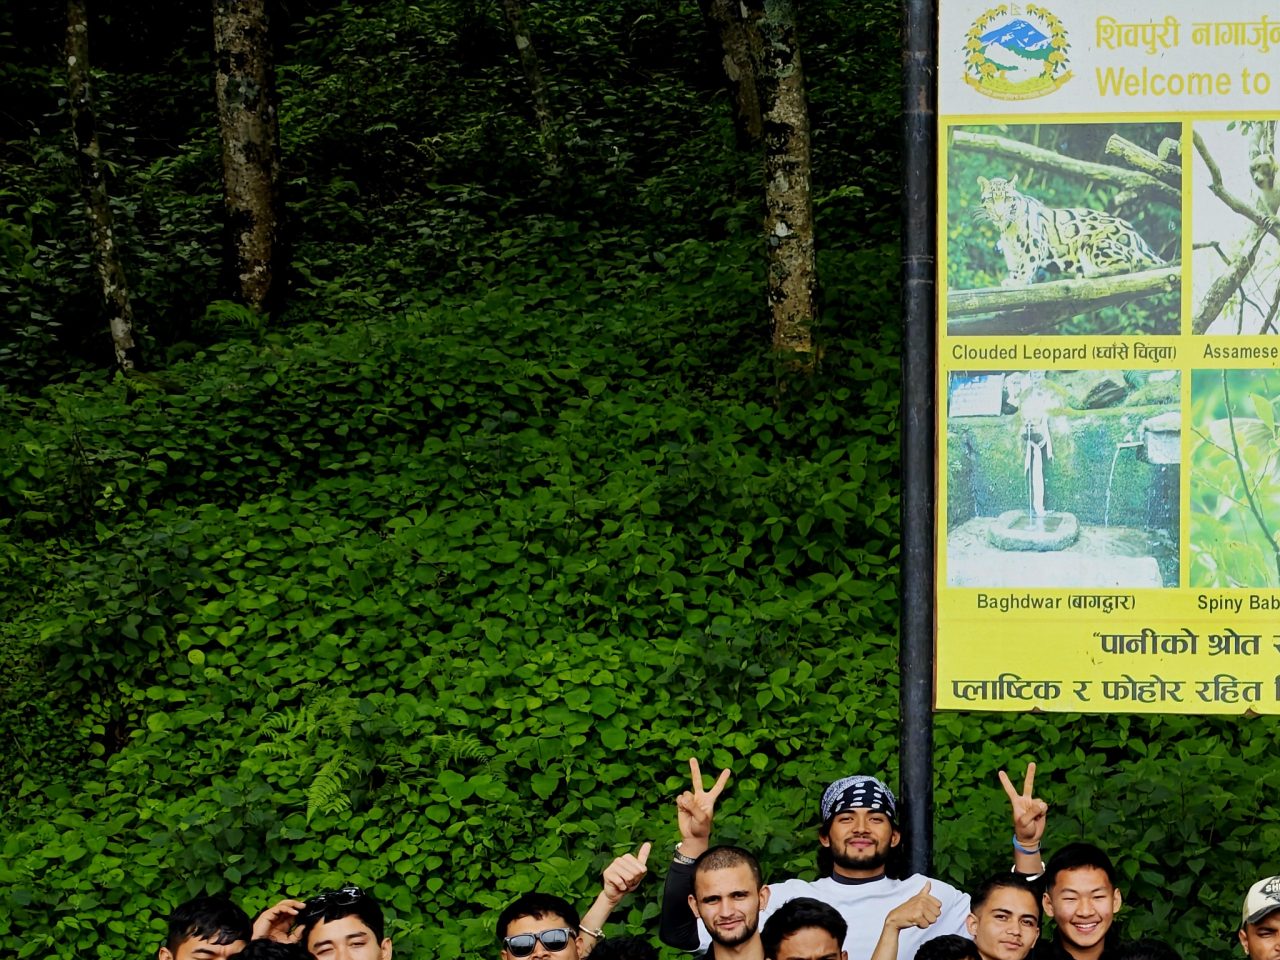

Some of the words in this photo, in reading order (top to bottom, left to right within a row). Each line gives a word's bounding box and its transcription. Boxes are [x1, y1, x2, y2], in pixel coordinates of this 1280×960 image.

[1096, 15, 1181, 55] शिवपुरी
[1096, 66, 1232, 96] Welcome
[1241, 67, 1271, 95] to
[952, 344, 1017, 360] Clouded
[1023, 343, 1087, 362] Leopard
[1203, 343, 1278, 359] Assamese
[977, 594, 1062, 612] Baghdwar
[1198, 594, 1243, 613] Spiny
[1208, 628, 1262, 656] श्रोत
[951, 672, 1063, 701] प्लाष्टिक
[1073, 680, 1093, 702] र
[1101, 674, 1186, 703] फोहोर
[1195, 674, 1264, 703] रहित
